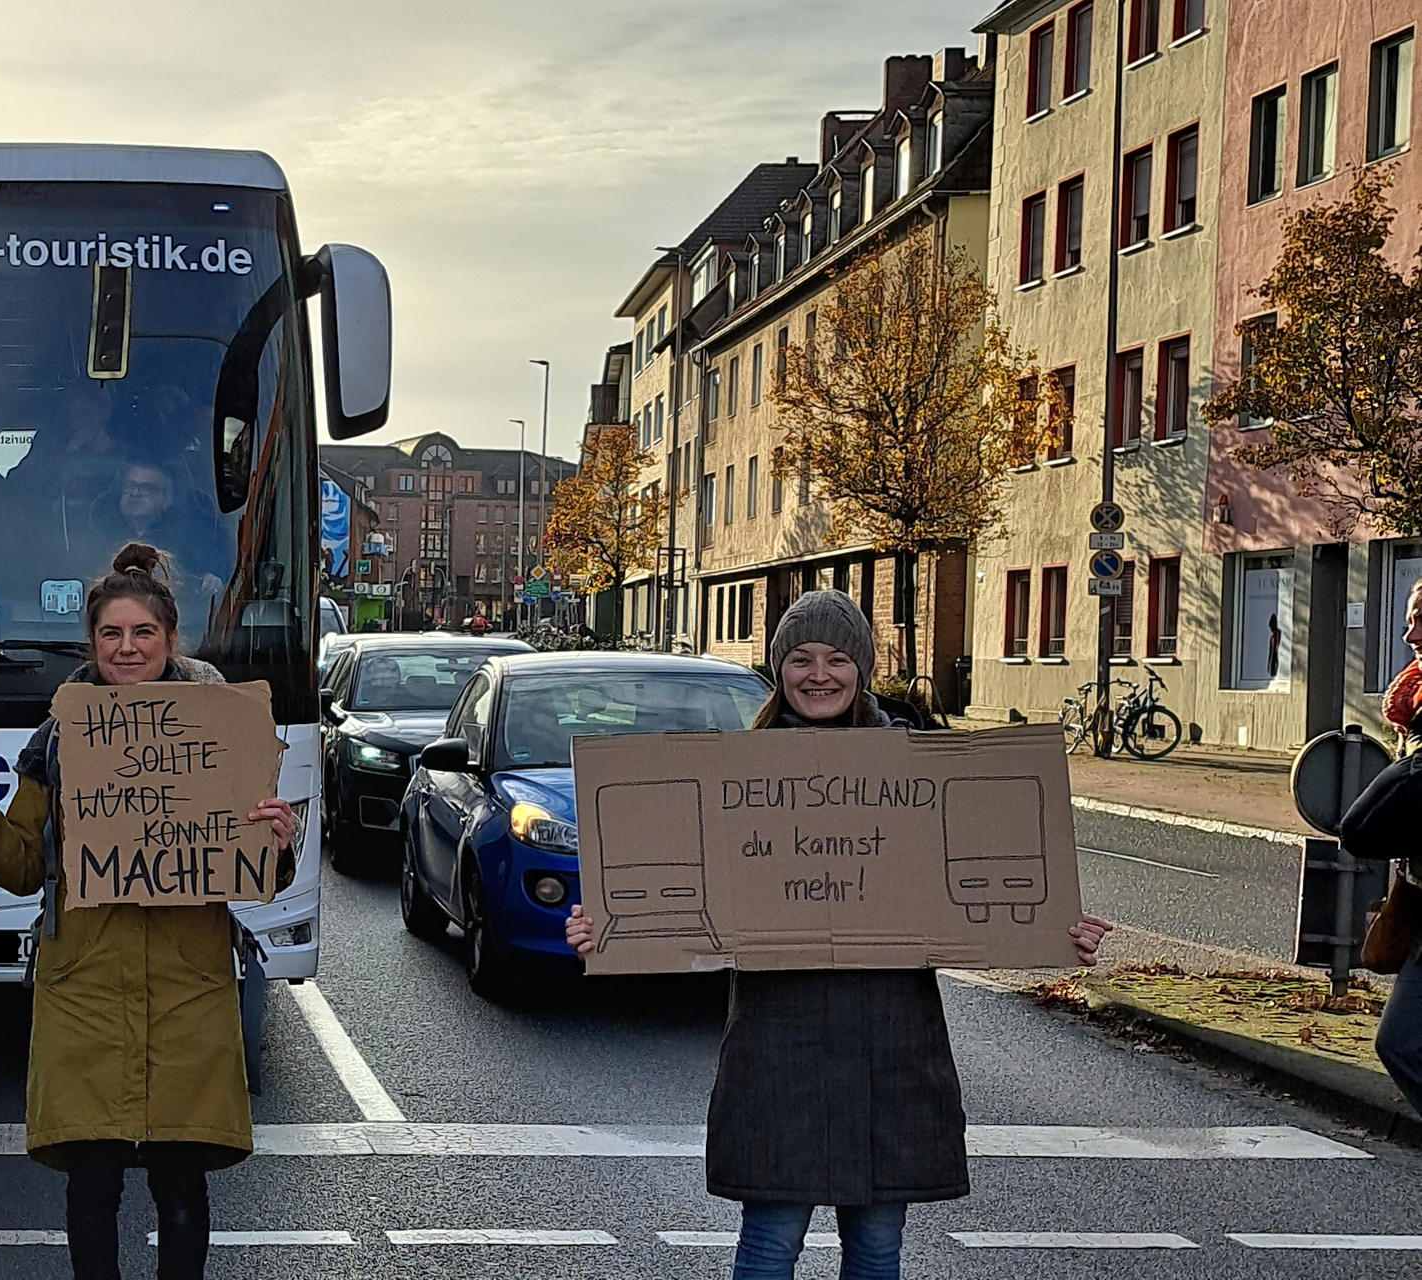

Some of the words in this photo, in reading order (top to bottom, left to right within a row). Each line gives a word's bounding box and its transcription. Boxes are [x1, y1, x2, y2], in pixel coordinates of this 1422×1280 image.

[83, 691, 184, 747] HÄTTE
[116, 742, 218, 778] SOLLTE
[77, 782, 176, 820] WÜRDE
[722, 775, 936, 810] DEUTSCHLAND,
[741, 830, 772, 857] du
[795, 826, 886, 857] kannst
[80, 844, 268, 899] MACHEN
[784, 866, 865, 901] mehr!
